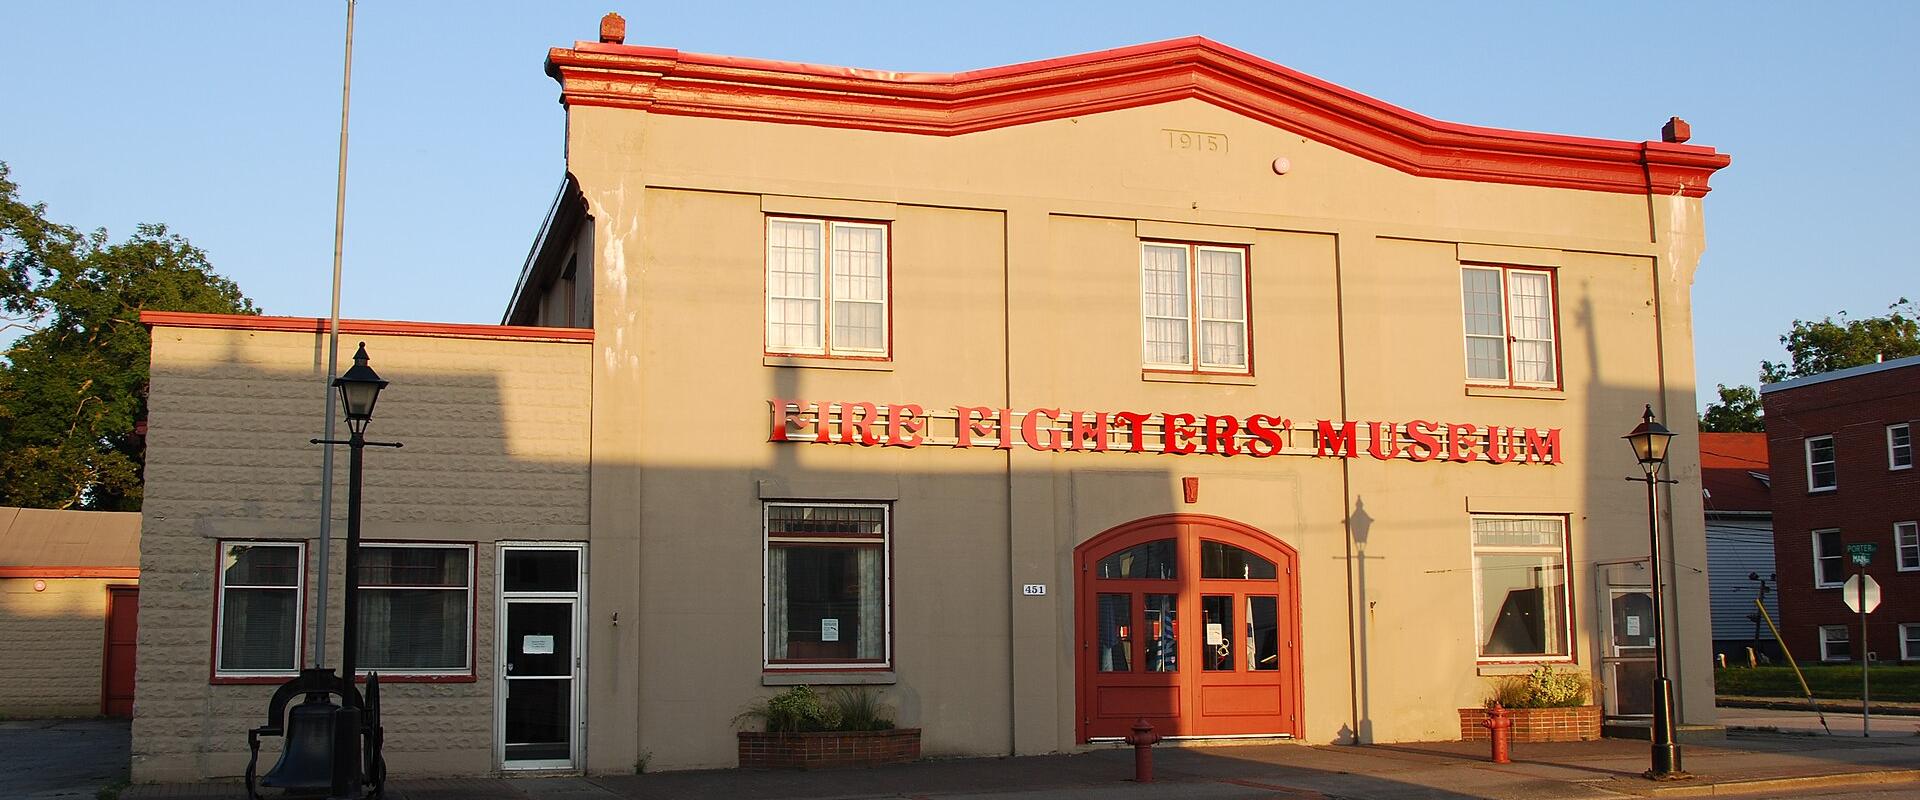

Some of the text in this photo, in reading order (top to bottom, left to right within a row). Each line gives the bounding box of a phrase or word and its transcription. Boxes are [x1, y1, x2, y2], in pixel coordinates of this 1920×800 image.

[1168, 132, 1218, 151] 1915
[769, 399, 1563, 464] FIRE FIGHTERS' MUSEUM
[1847, 544, 1872, 552] PORTER
[1025, 585, 1044, 594] 451
